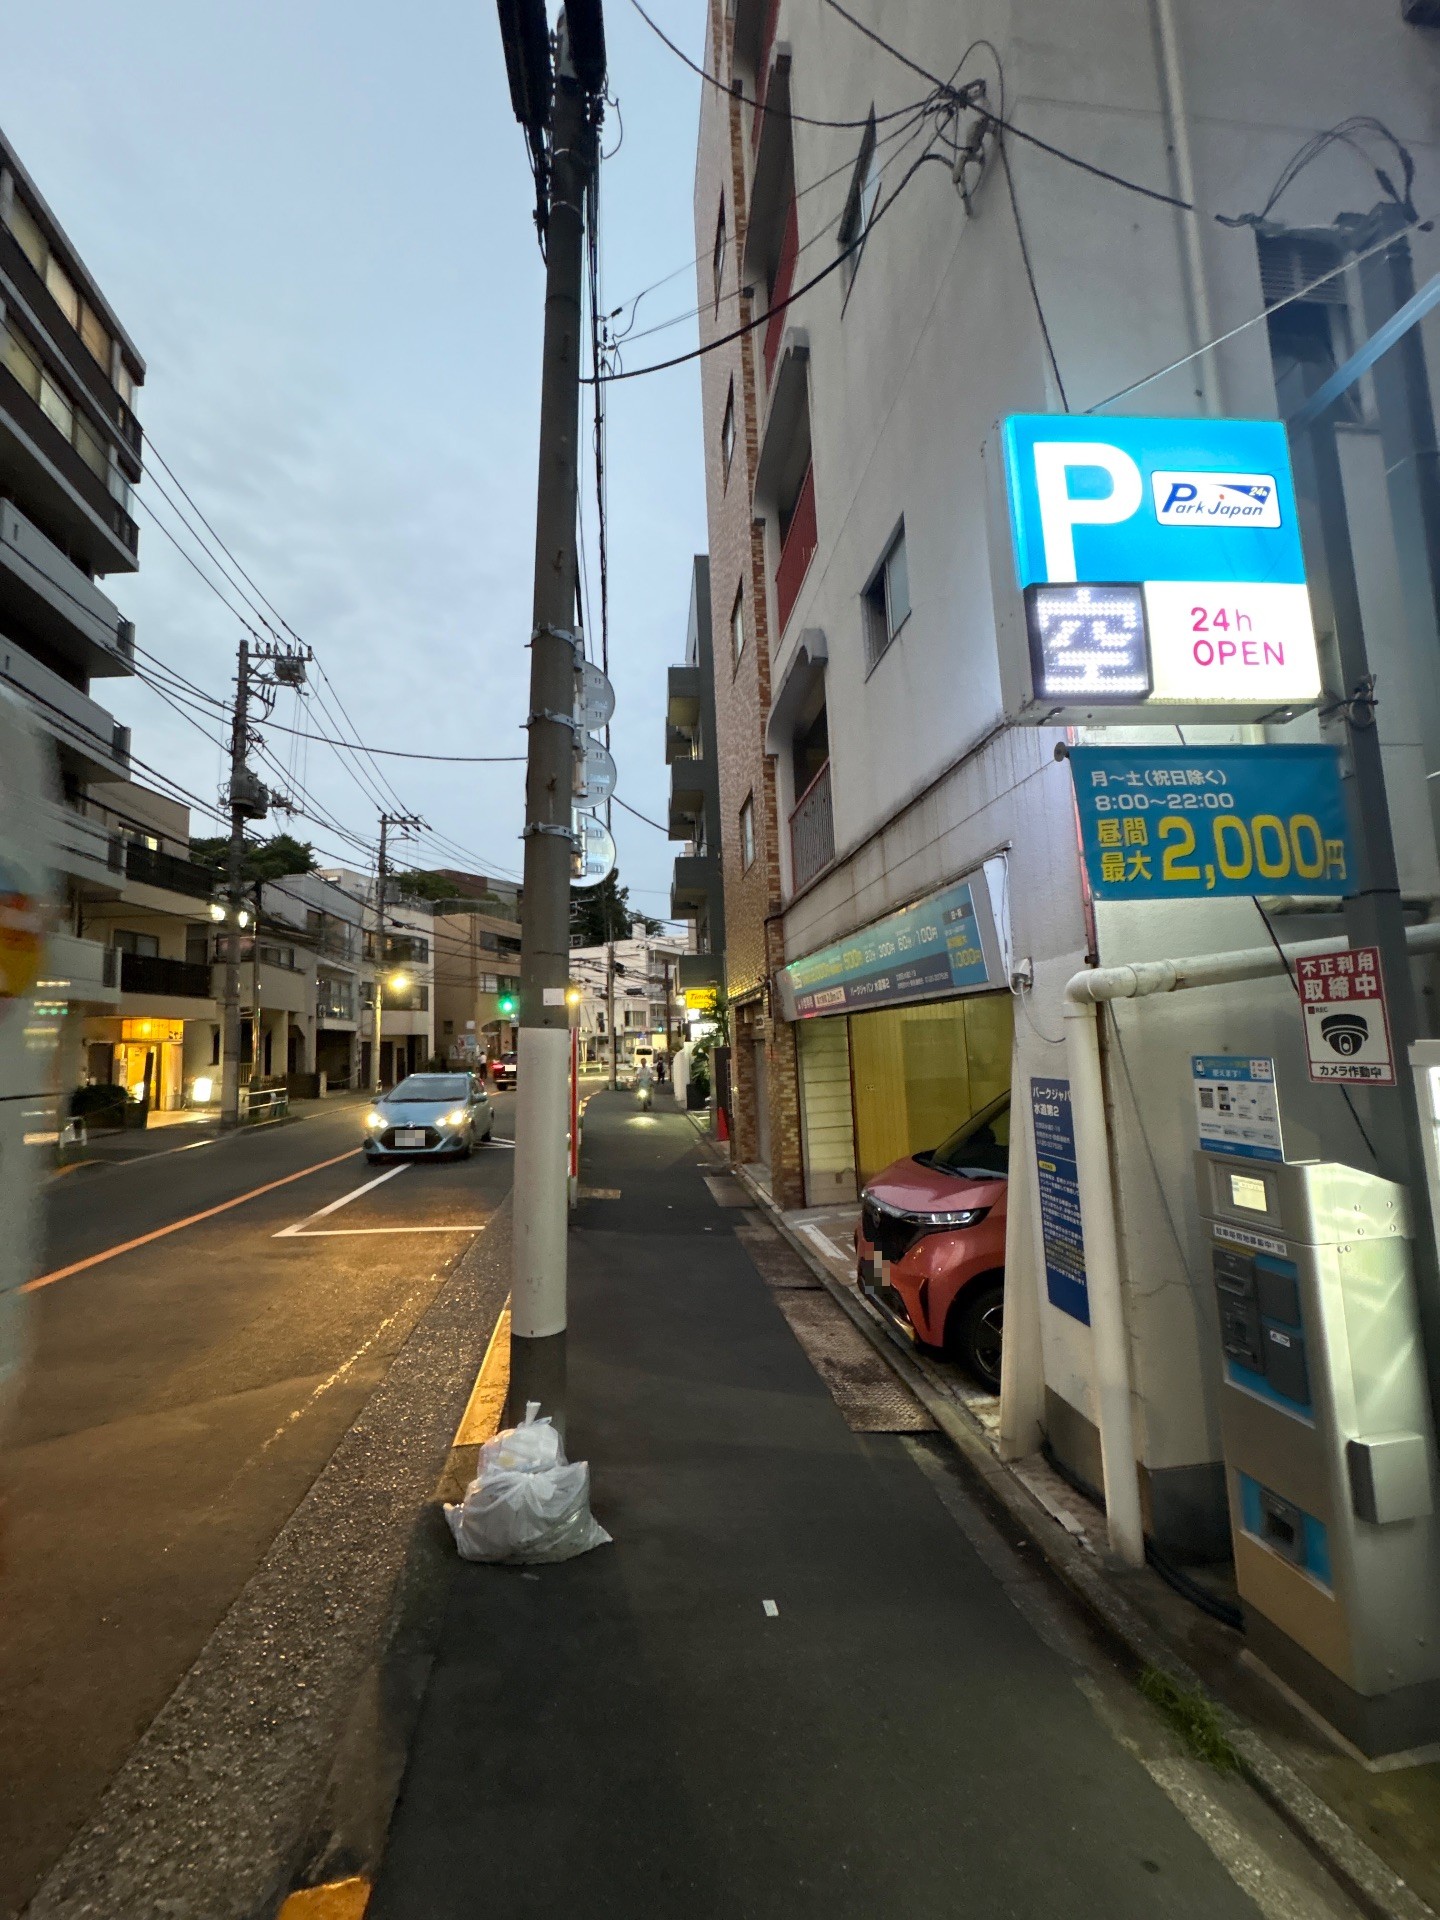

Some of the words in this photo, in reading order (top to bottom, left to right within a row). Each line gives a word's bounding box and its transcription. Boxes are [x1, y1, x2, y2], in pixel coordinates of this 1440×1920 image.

[1033, 441, 1143, 582] P
[1162, 483, 1205, 513] Park
[1208, 494, 1263, 518] Japan
[1190, 606, 1252, 633] 24h
[1037, 589, 1148, 693] 空
[1193, 639, 1285, 667] OPEN
[1097, 816, 1150, 848] 昼間
[1101, 850, 1153, 883] 最大
[1158, 813, 1347, 890] 2,000円
[1301, 952, 1374, 977] 不正利用
[1303, 973, 1377, 1001] 取締中
[1319, 1065, 1382, 1079] カメラ作動中
